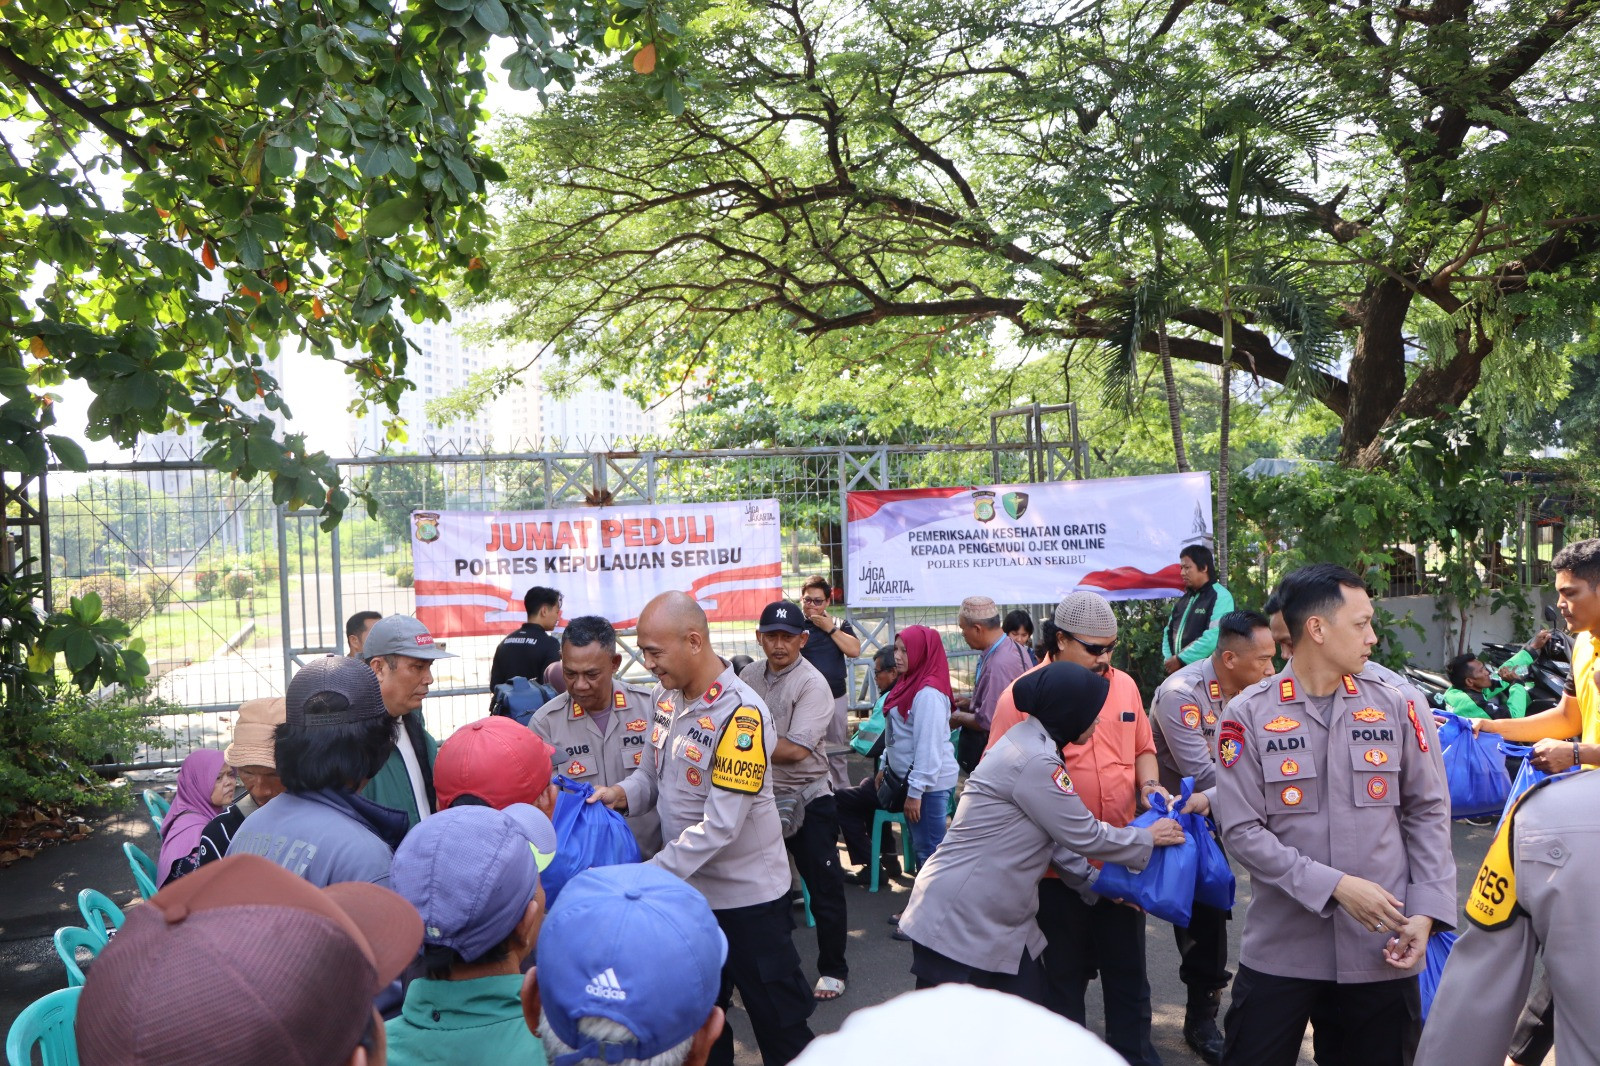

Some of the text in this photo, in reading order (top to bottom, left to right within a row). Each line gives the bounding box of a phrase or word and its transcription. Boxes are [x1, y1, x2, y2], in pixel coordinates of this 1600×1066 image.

[485, 515, 715, 551] JUMAT PEDULI
[908, 523, 1106, 542] PEMERIKSAAN KESEHATAN GRATIS
[911, 538, 1105, 556] KEPADA PENGEMUDI OJEK ONLINE
[455, 547, 741, 576] POLRES KEPULAUAN SERIBU
[927, 555, 1086, 569] POLRES KEPULAUAN SERIBU
[859, 566, 885, 581] JAGA
[687, 727, 713, 748] POLRI
[1266, 736, 1306, 752] ALDI
[1352, 729, 1394, 741] POLRI
[734, 760, 752, 778] OPS
[1475, 865, 1509, 904] RES
[1475, 900, 1495, 916] 2025
[585, 984, 626, 1000] adidas
